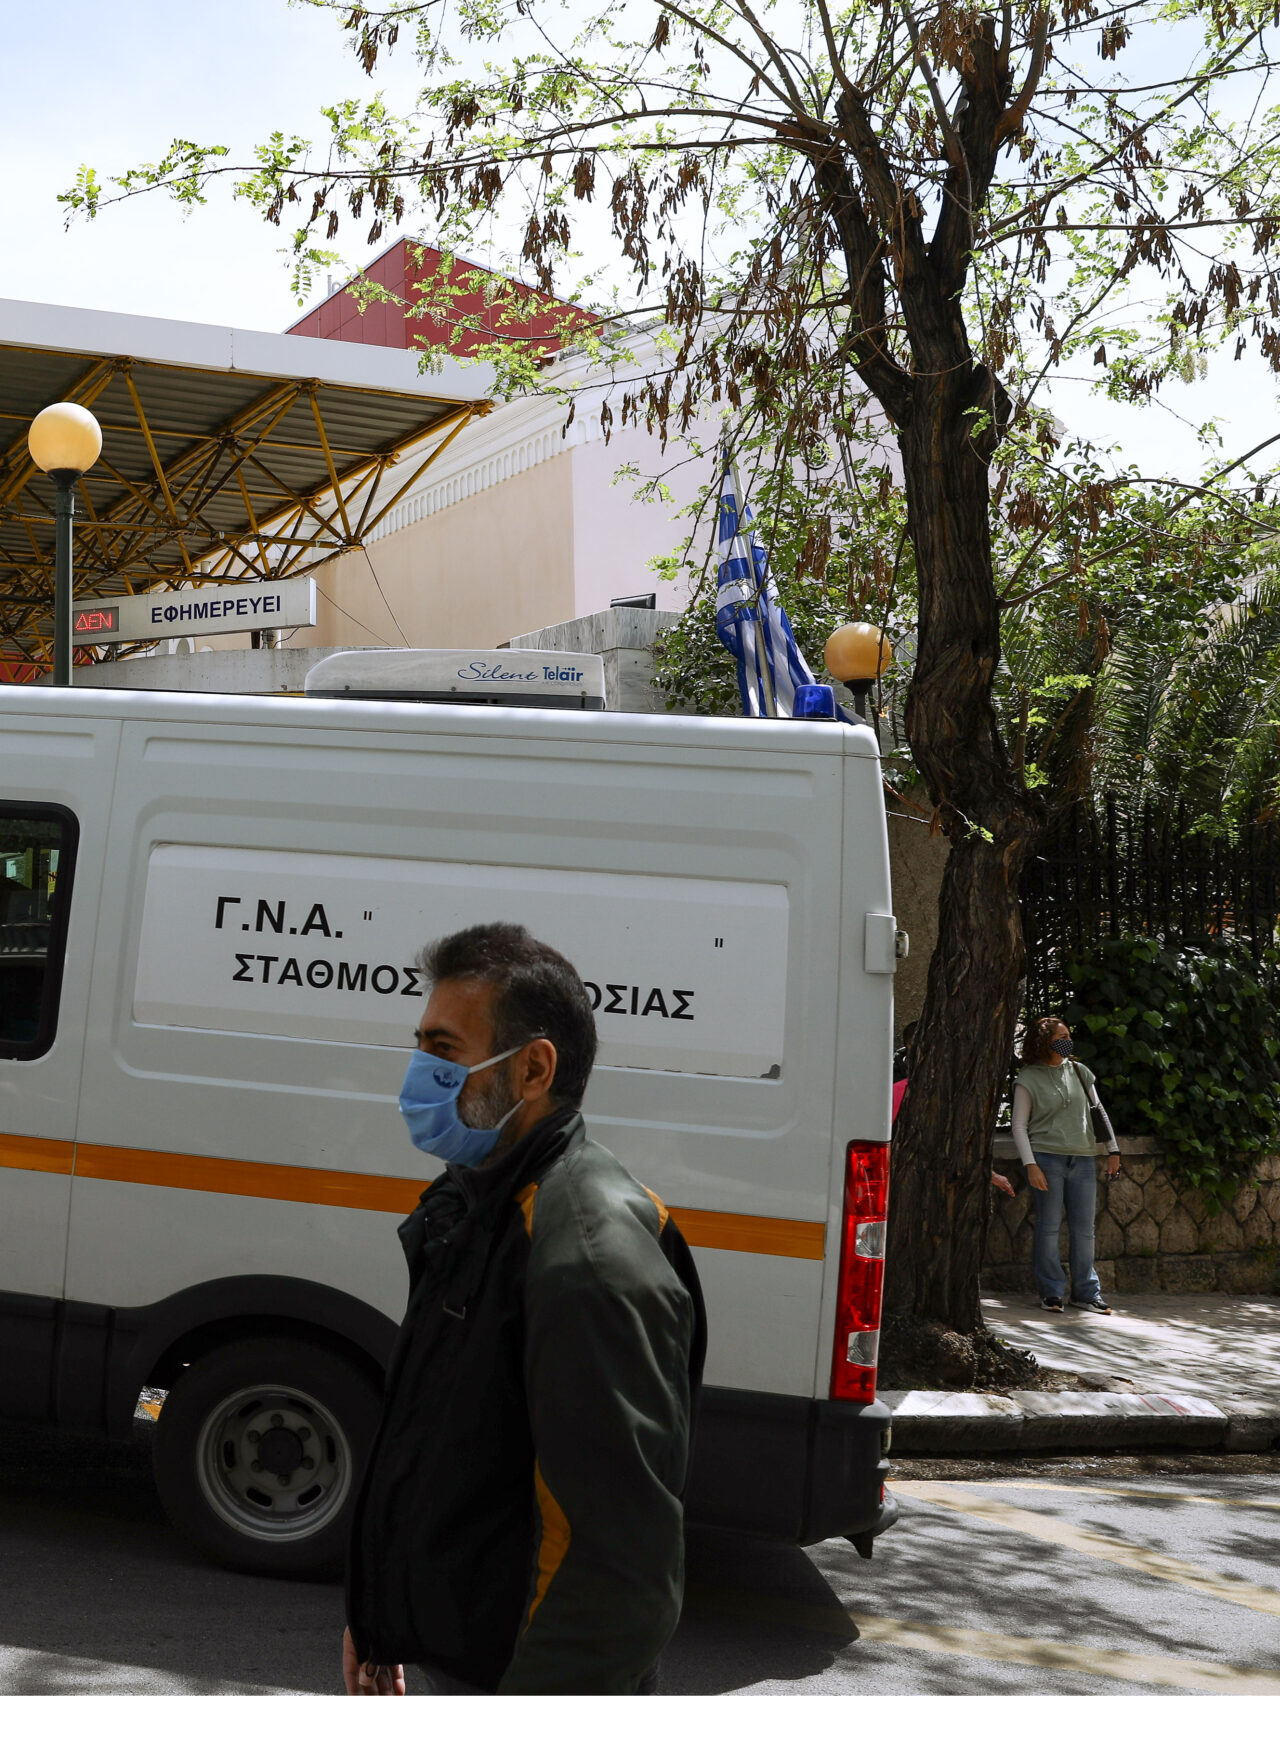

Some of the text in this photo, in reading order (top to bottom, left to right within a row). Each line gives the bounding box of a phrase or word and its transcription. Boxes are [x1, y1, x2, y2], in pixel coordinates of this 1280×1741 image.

[75, 595, 281, 631] ΔΕΝ ΕΦΗΜΕΡΕΥΕΙ
[457, 662, 539, 681] Silent
[215, 896, 343, 939] Γ.Ν.Α.
[232, 953, 695, 1020] ΣΤΑΘΜΟΣ ΟΣΙΑΣ
